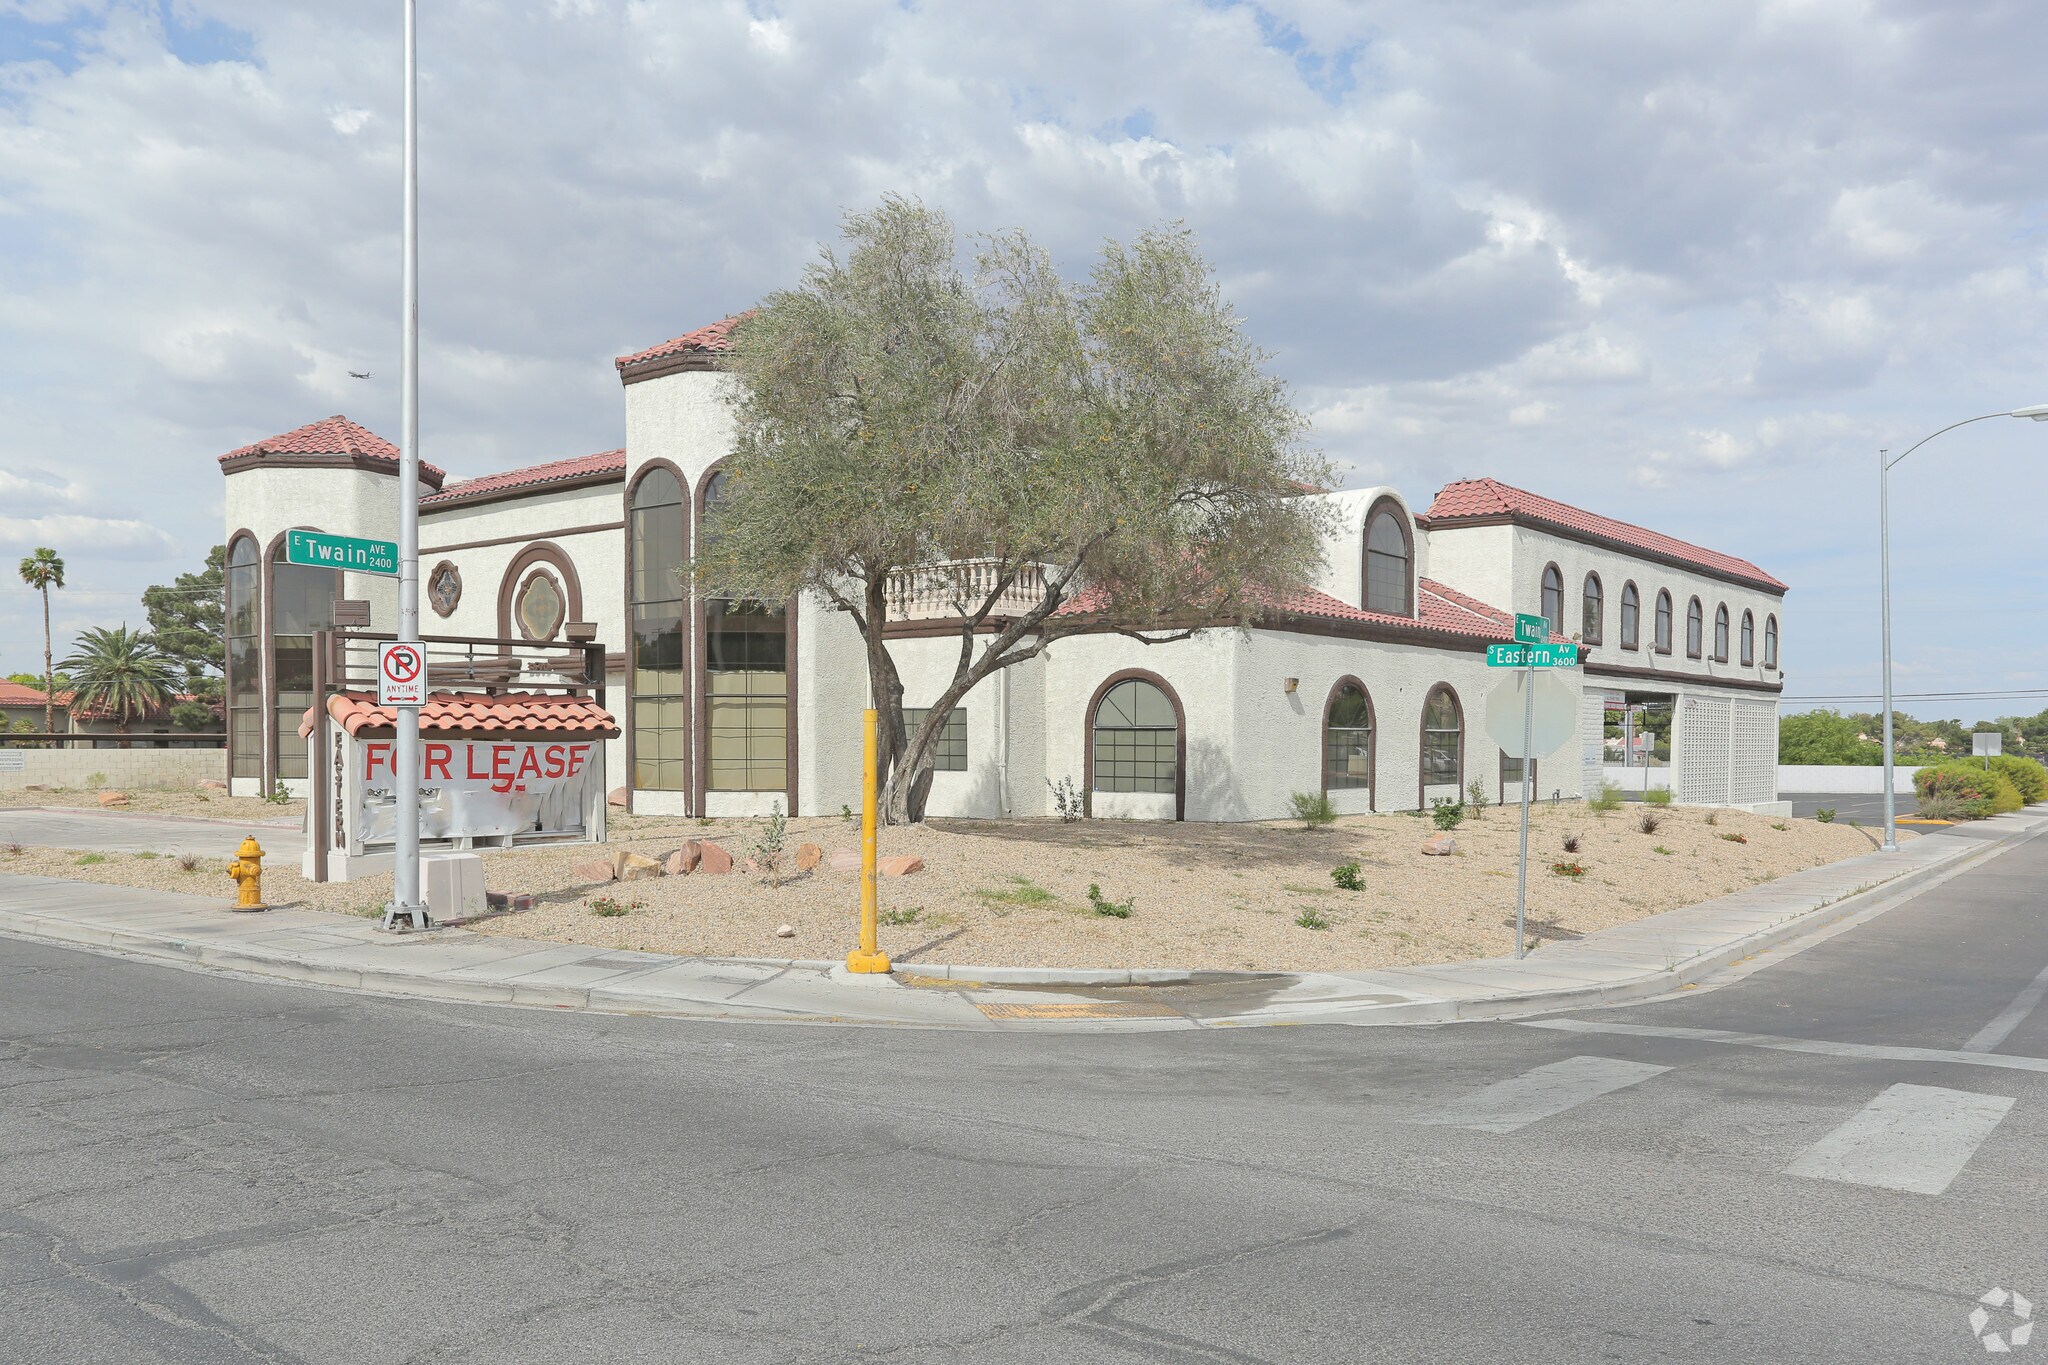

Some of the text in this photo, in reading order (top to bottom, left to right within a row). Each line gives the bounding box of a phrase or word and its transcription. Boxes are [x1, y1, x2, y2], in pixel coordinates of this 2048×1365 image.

[294, 535, 386, 564] E Twain AVE
[369, 556, 392, 569] 2400
[1520, 620, 1541, 638] Twain
[1489, 645, 1570, 664] S Eastern Av
[1552, 657, 1575, 666] 3600
[386, 685, 419, 693] ANYTIME
[366, 743, 591, 780] FR LEASE
[334, 731, 346, 850] EASTERN
